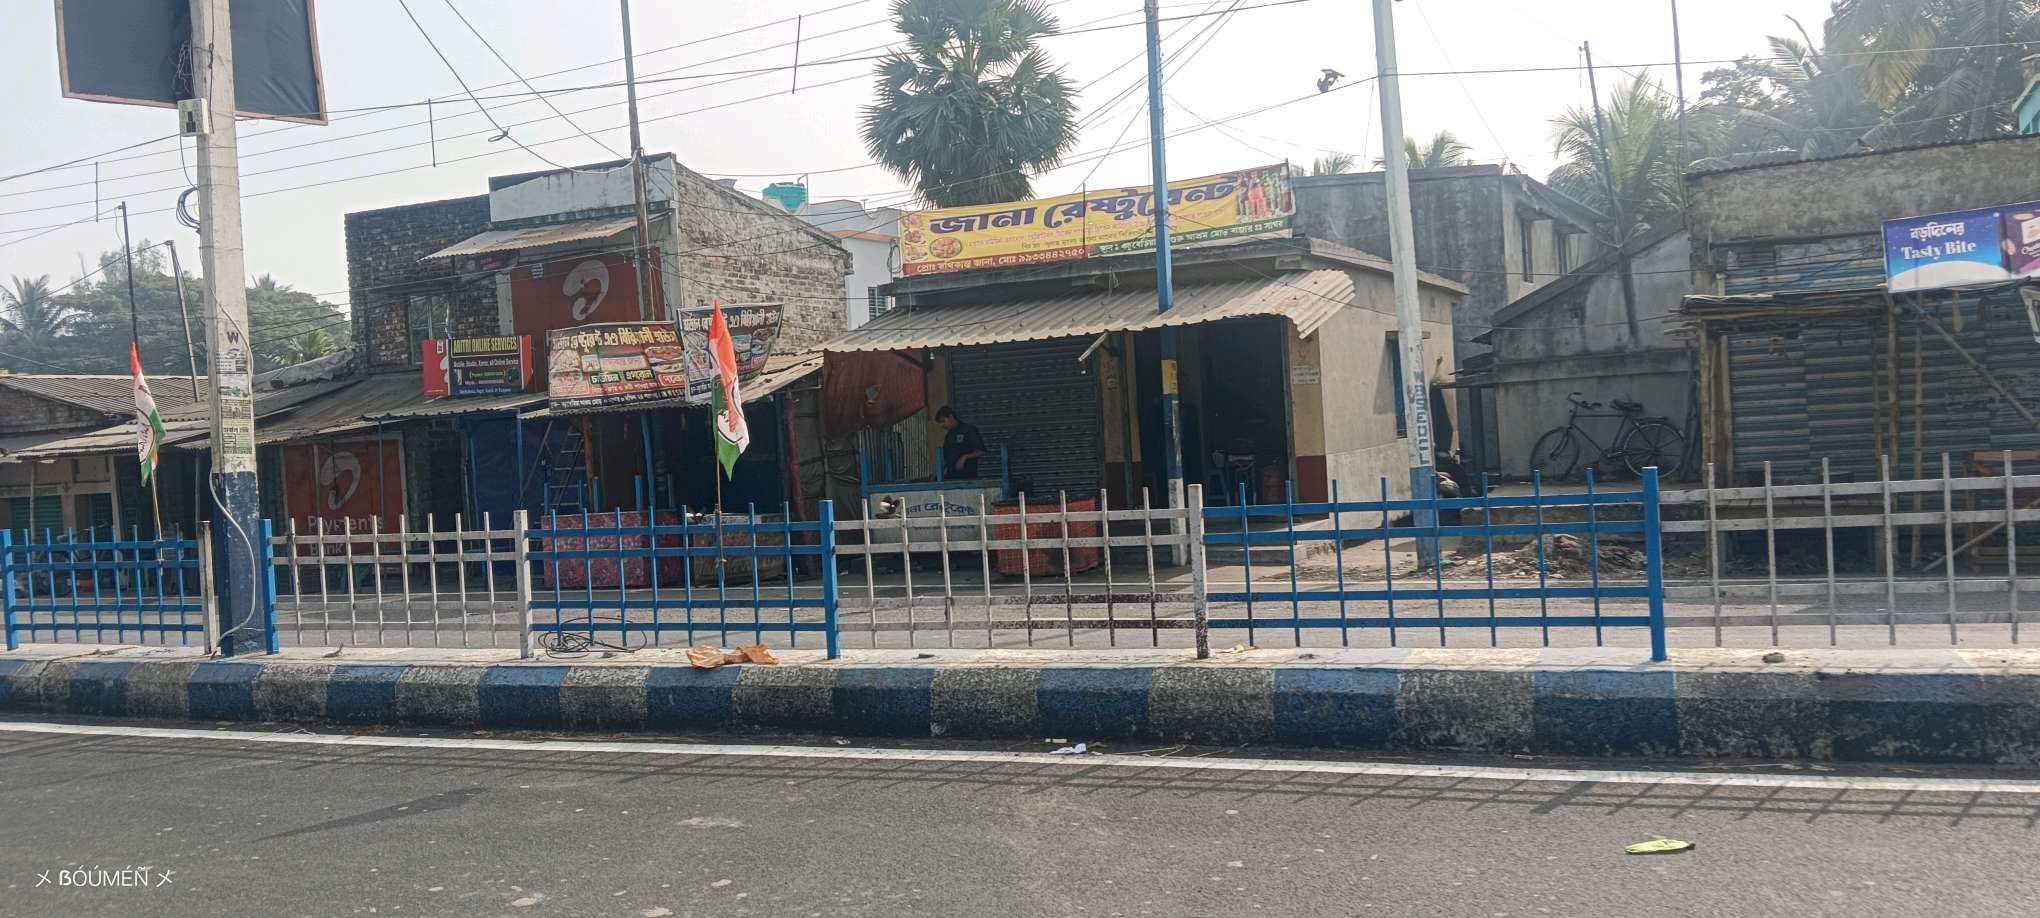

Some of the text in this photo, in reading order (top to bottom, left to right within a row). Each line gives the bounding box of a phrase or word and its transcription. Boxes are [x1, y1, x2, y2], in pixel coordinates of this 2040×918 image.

[929, 207, 1038, 234] জানা
[1909, 221, 1965, 241] বড়দিনের
[1901, 240, 1977, 260] Tasty Bite
[490, 336, 517, 352] SERVICES
